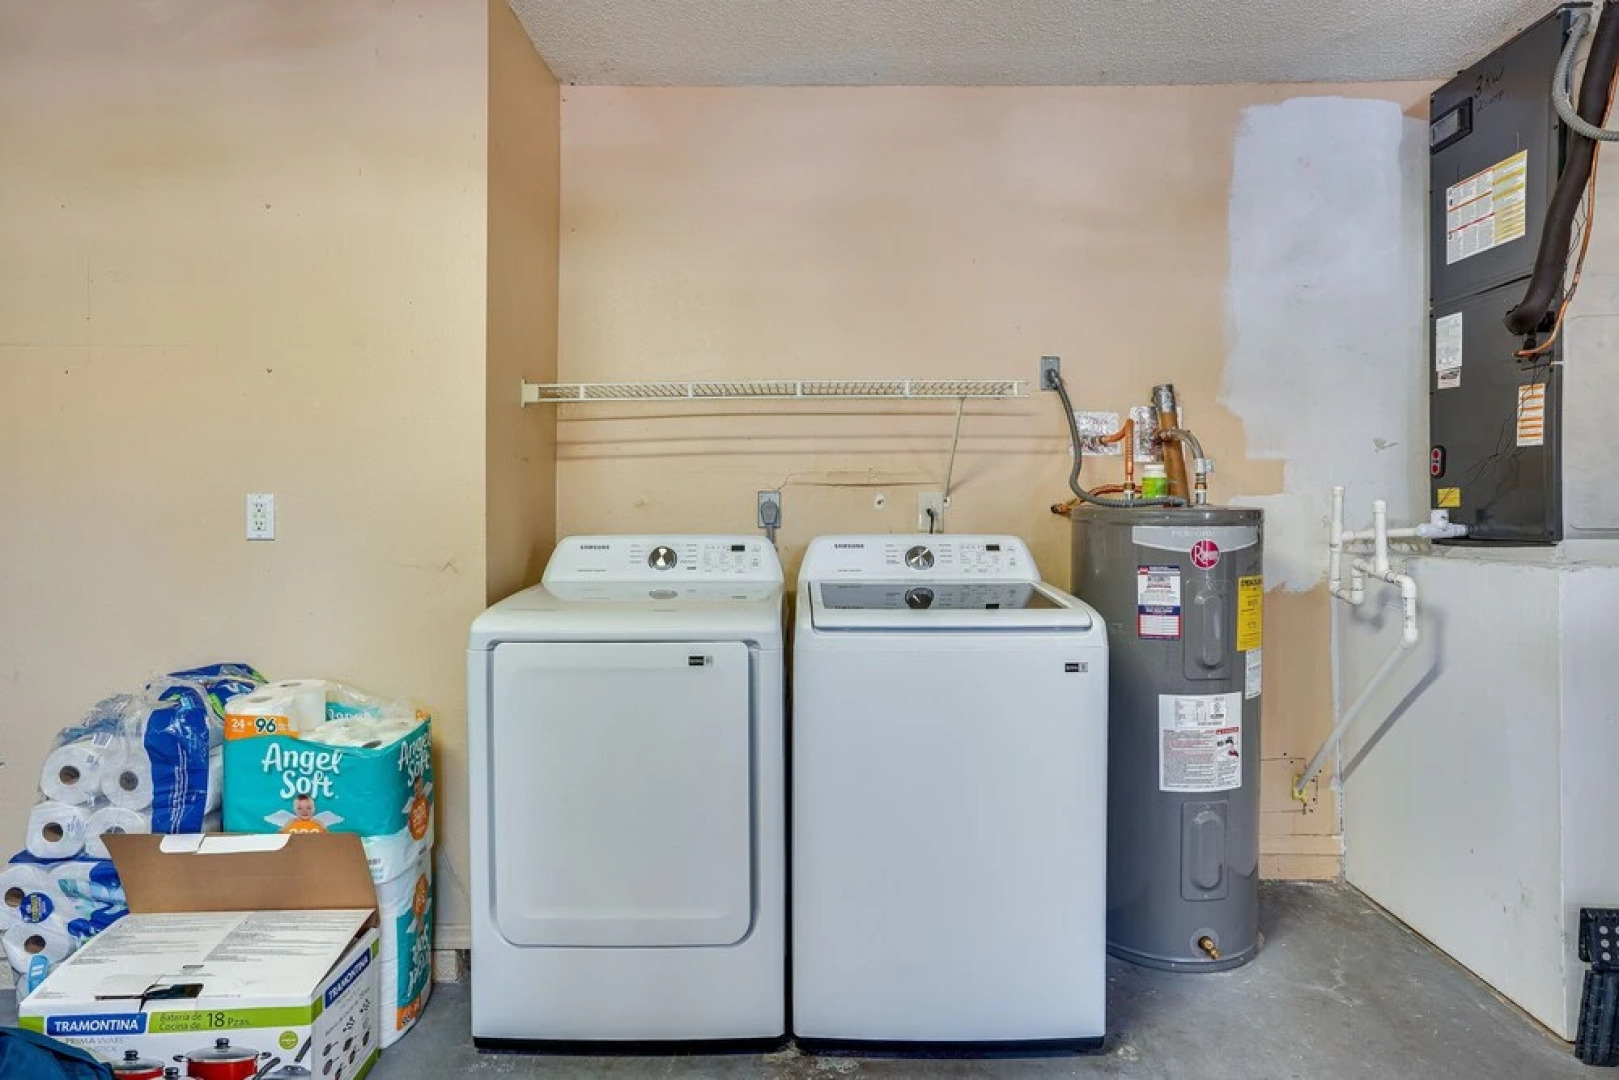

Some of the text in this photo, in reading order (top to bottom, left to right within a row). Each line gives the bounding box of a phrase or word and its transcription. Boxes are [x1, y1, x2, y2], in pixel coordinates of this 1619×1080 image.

[231, 717, 276, 733] 24 96
[261, 742, 343, 775] Angel
[279, 770, 334, 799] Soft
[328, 954, 369, 1001] TRAMONTINA
[54, 1017, 139, 1032] TRAMONTINA
[159, 1022, 189, 1031] Cocina
[207, 1011, 225, 1027] 18
